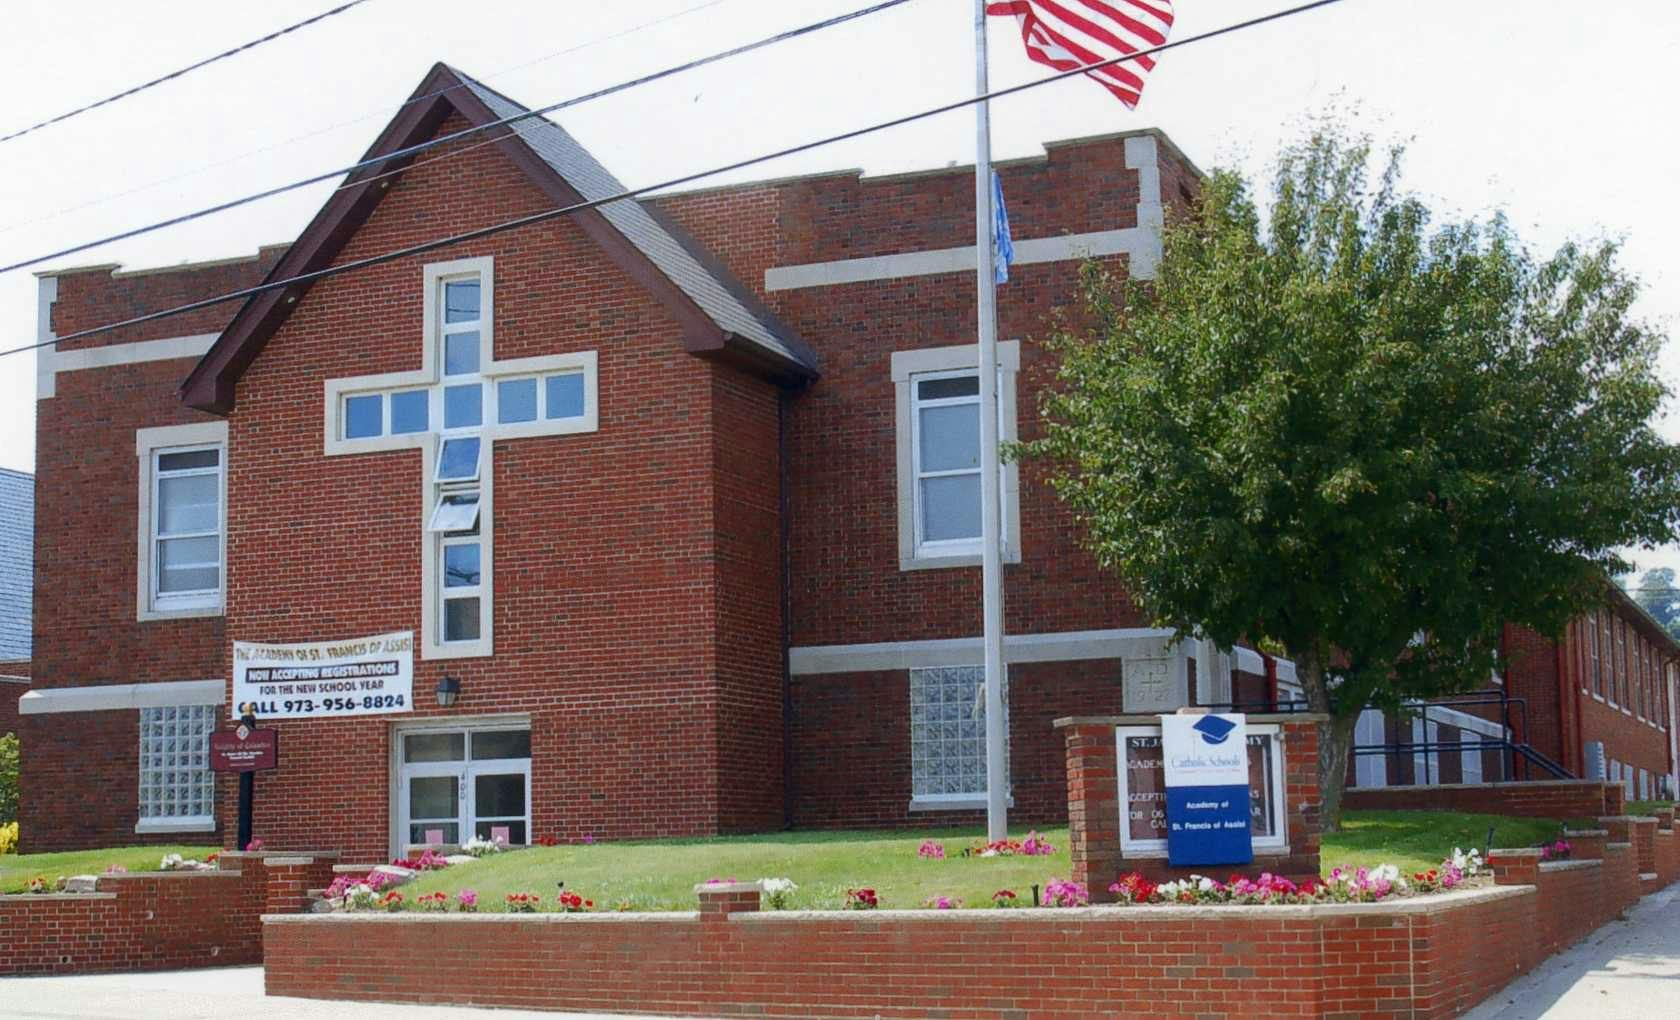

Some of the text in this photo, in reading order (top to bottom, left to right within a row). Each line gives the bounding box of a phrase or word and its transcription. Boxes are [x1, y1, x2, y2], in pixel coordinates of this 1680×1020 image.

[236, 648, 250, 661] THE
[251, 648, 294, 661] ACADEMY
[296, 648, 308, 661] OF
[326, 643, 367, 658] FRANCIS
[369, 641, 382, 655] OF
[383, 637, 411, 652] ASSISI
[249, 662, 396, 681] NOW ACCEPTING REGISTRATIONS
[260, 680, 384, 695] FOR THE NEW SCHOOL YEAR
[238, 694, 404, 714] CALL 973-956-8824
[1128, 760, 1164, 769] CADEM
[1209, 752, 1241, 768] Schools
[1129, 792, 1167, 802] CCEPTI
[1186, 800, 1229, 810] Academy of
[1185, 822, 1212, 831] Francis
[1213, 821, 1221, 829] of
[1224, 820, 1246, 828] Assisi
